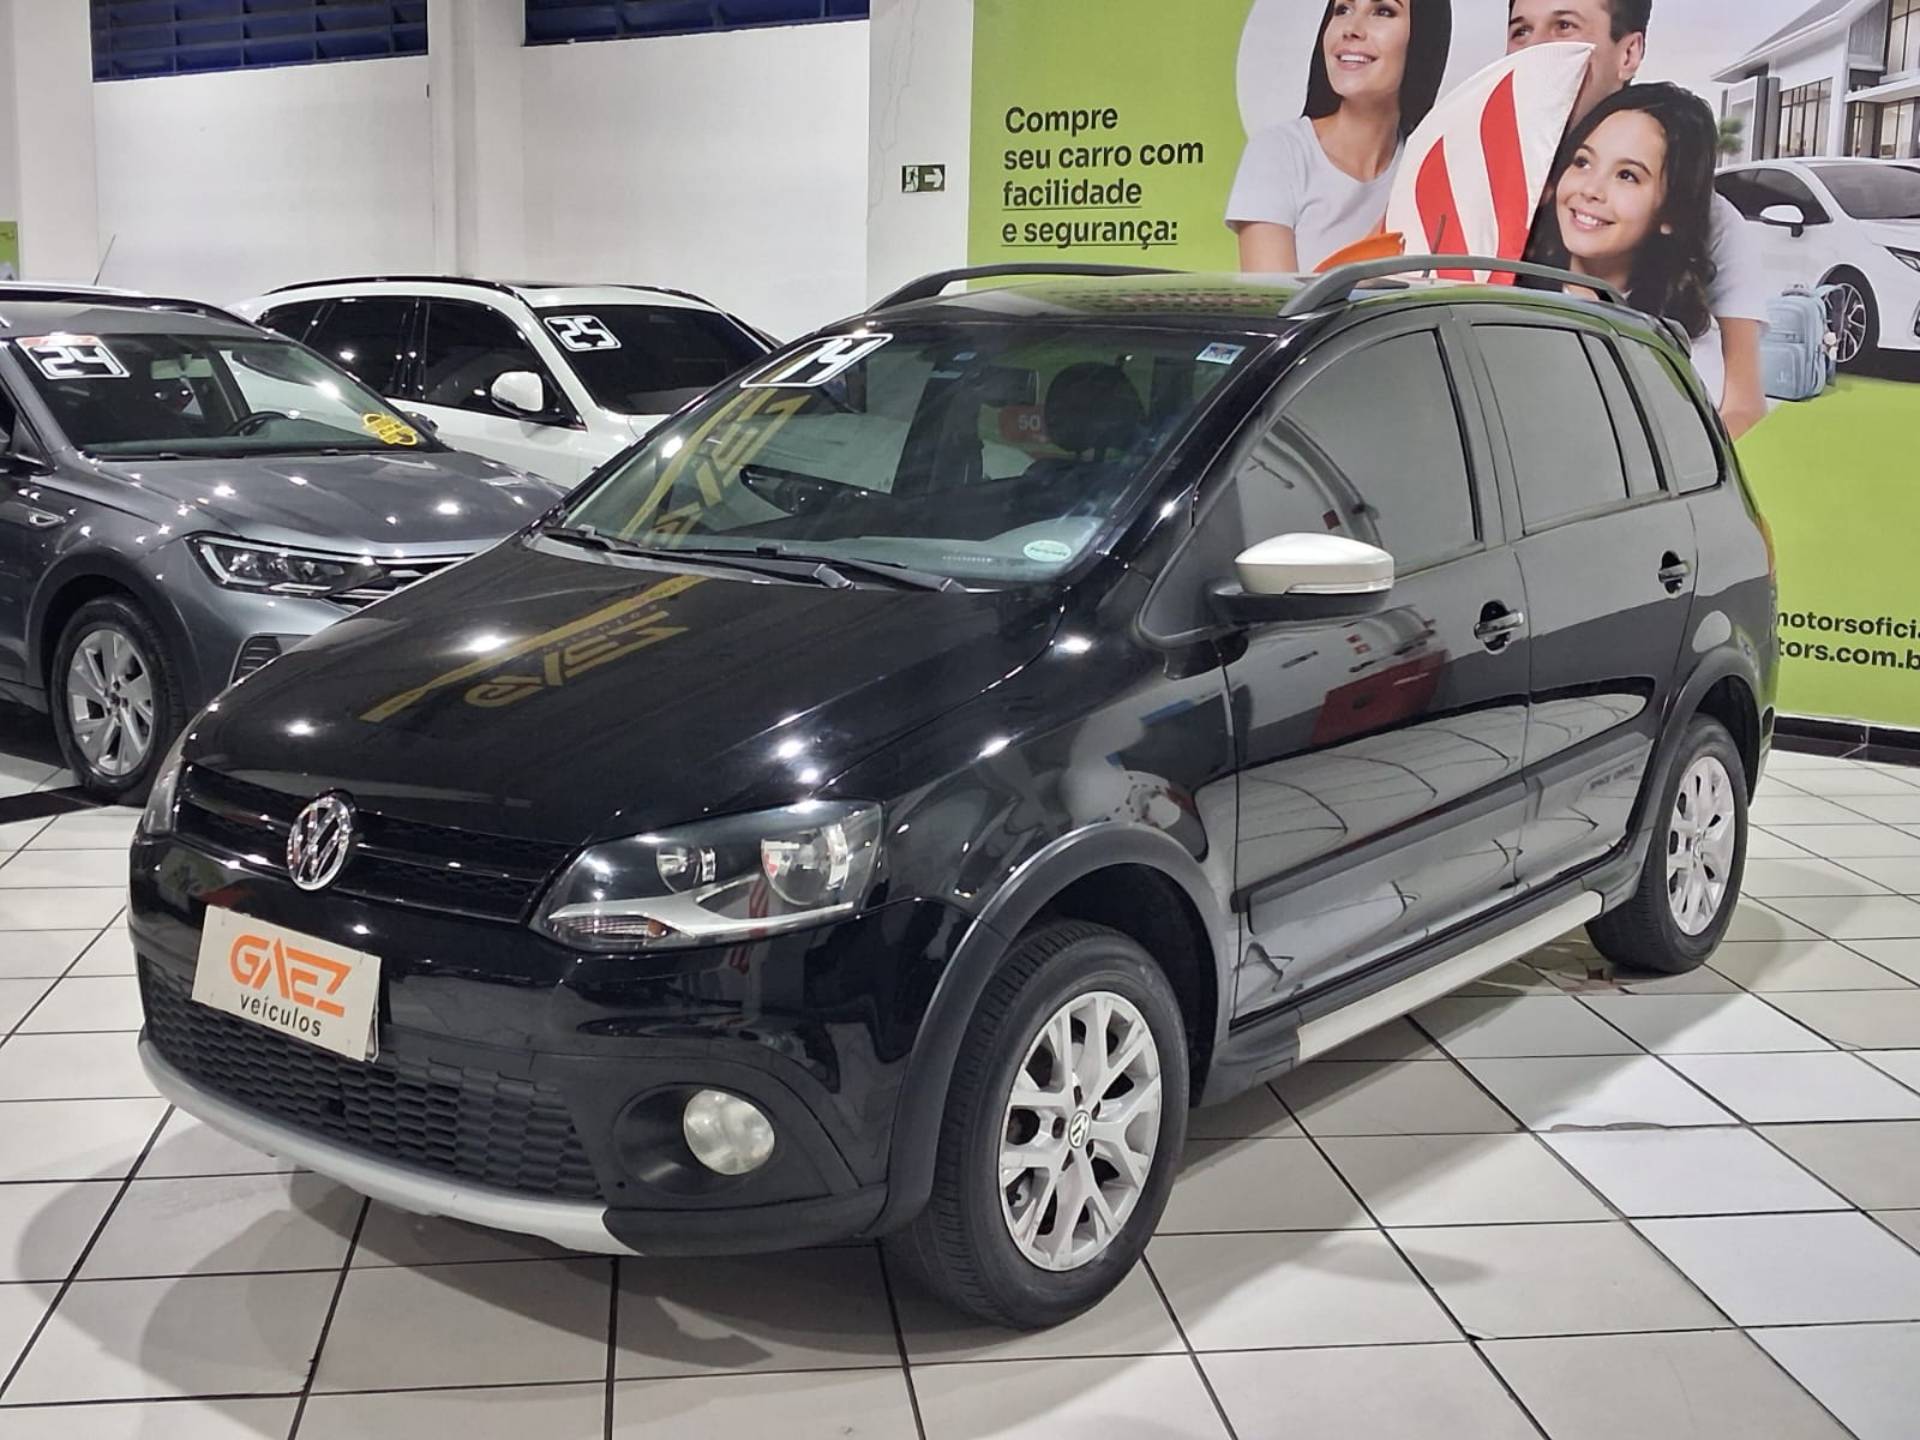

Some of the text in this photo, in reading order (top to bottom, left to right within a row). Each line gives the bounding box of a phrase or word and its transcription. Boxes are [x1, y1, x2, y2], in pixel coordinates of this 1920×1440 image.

[1005, 107, 1118, 136] Compre
[1004, 141, 1204, 170] seu carro com
[1002, 178, 1142, 206] facilidade
[1002, 219, 1178, 249] e segurança:
[549, 317, 616, 349] 25
[29, 345, 122, 376] 24
[1777, 612, 1920, 639] otorsofici
[239, 992, 322, 1038] veículos
